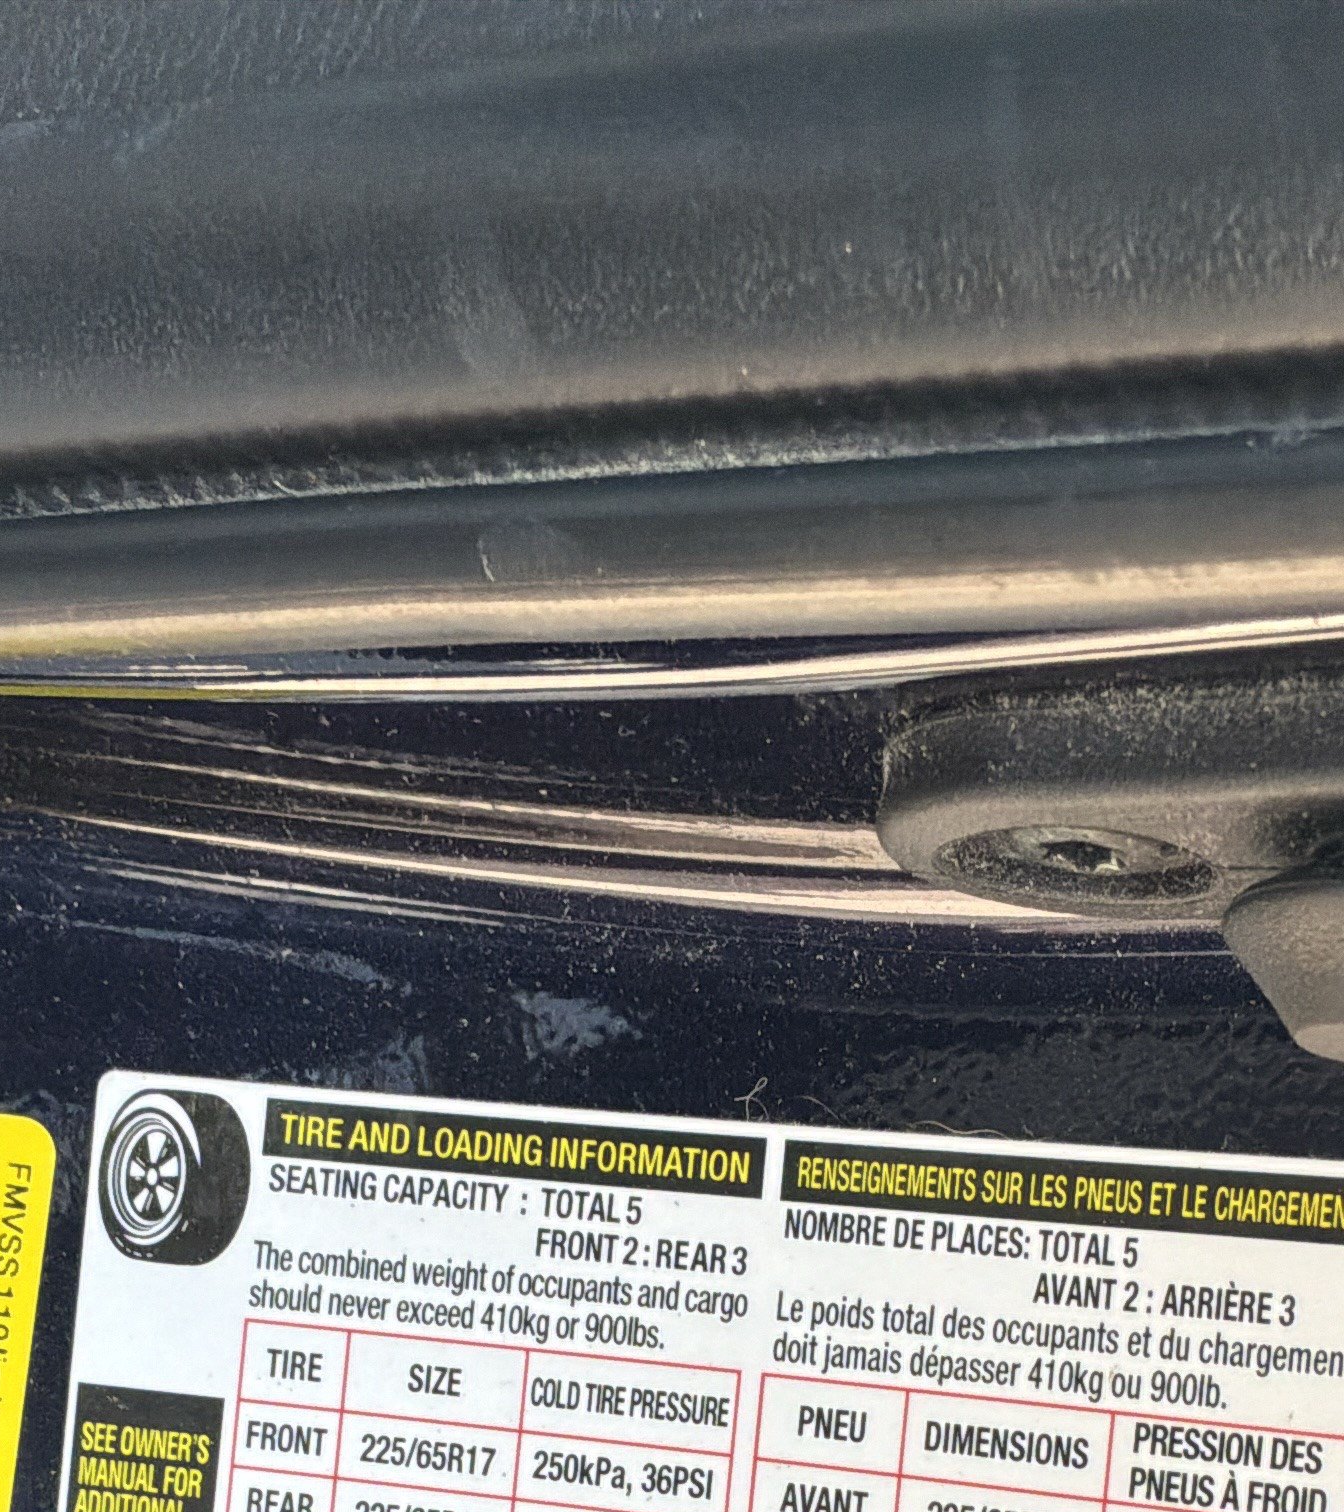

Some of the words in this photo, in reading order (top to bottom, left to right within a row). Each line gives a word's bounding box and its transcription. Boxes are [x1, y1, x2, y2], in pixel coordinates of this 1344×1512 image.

[280, 1113, 344, 1149] TIRE
[348, 1120, 410, 1154] AND
[417, 1125, 543, 1166] LOADING
[549, 1137, 750, 1184] INFORMATION
[268, 1163, 377, 1201] SEATING
[383, 1173, 509, 1213] CAPACITY
[541, 1187, 621, 1224] TOTAL
[626, 1195, 643, 1225] 5
[797, 1156, 977, 1202] RENSEIGNEMENTS
[980, 1169, 1024, 1205] SUR
[1029, 1173, 1068, 1209] LES
[1073, 1176, 1143, 1214] PNEUS
[1149, 1181, 1177, 1216] ET
[1181, 1184, 1208, 1219] LE
[535, 1227, 620, 1263] FRONT
[622, 1236, 639, 1266] 2
[655, 1238, 727, 1274] REAR
[731, 1246, 748, 1276] 3
[784, 1208, 887, 1247] NOMBRE
[893, 1217, 926, 1251] DE
[930, 1220, 1031, 1259] PLACES:
[1039, 1229, 1116, 1267] TOTAL
[1122, 1237, 1139, 1269] 5
[253, 1239, 293, 1272] The
[297, 1248, 408, 1283] combined
[412, 1257, 488, 1297] weight
[491, 1264, 516, 1294] of
[518, 1272, 633, 1308] occupants
[637, 1280, 681, 1311] and
[684, 1289, 749, 1324] cargo
[1032, 1272, 1118, 1310] AVANT
[1122, 1280, 1140, 1313] 2
[1160, 1283, 1273, 1325] ARRIÈRE
[1278, 1294, 1296, 1327] 3
[248, 1278, 323, 1314] should
[327, 1293, 391, 1321] never
[396, 1299, 476, 1330] exceed
[480, 1302, 550, 1345] 410kg
[555, 1316, 581, 1340] or
[584, 1312, 665, 1350] 900lbs.
[776, 1290, 804, 1323] Le
[809, 1296, 875, 1332] poids
[882, 1301, 936, 1337] total
[942, 1307, 986, 1341] des
[992, 1318, 1120, 1356] occupants
[1127, 1326, 1152, 1359] et
[1159, 1327, 1191, 1362] du
[266, 1348, 323, 1383] TIRE
[407, 1363, 462, 1397] SIZE
[772, 1331, 818, 1366] doit
[821, 1335, 902, 1375] jamais
[909, 1344, 1022, 1387] dépasser
[1027, 1357, 1104, 1404] 410kg
[1111, 1372, 1142, 1400] ou
[1150, 1370, 1227, 1410] 900lb.
[530, 1376, 581, 1411] COLD
[585, 1382, 627, 1416] TIRE
[629, 1387, 730, 1428] PRESSURE
[797, 1405, 867, 1443] PNEU
[81, 1421, 118, 1454] SEE
[120, 1425, 210, 1465] OWNER'S
[245, 1420, 328, 1457] FRONT
[359, 1433, 497, 1476] 225/65R17
[924, 1420, 1089, 1470] DIMENSIONS
[1133, 1422, 1264, 1468] PRESSION
[1270, 1437, 1323, 1475] DES
[77, 1455, 159, 1494] MANUAL
[162, 1465, 203, 1498] FOR
[532, 1450, 632, 1497] 250kPa,
[641, 1462, 714, 1500] 36PSI
[1128, 1466, 1215, 1508] PNEUS
[1220, 1469, 1240, 1512] À
